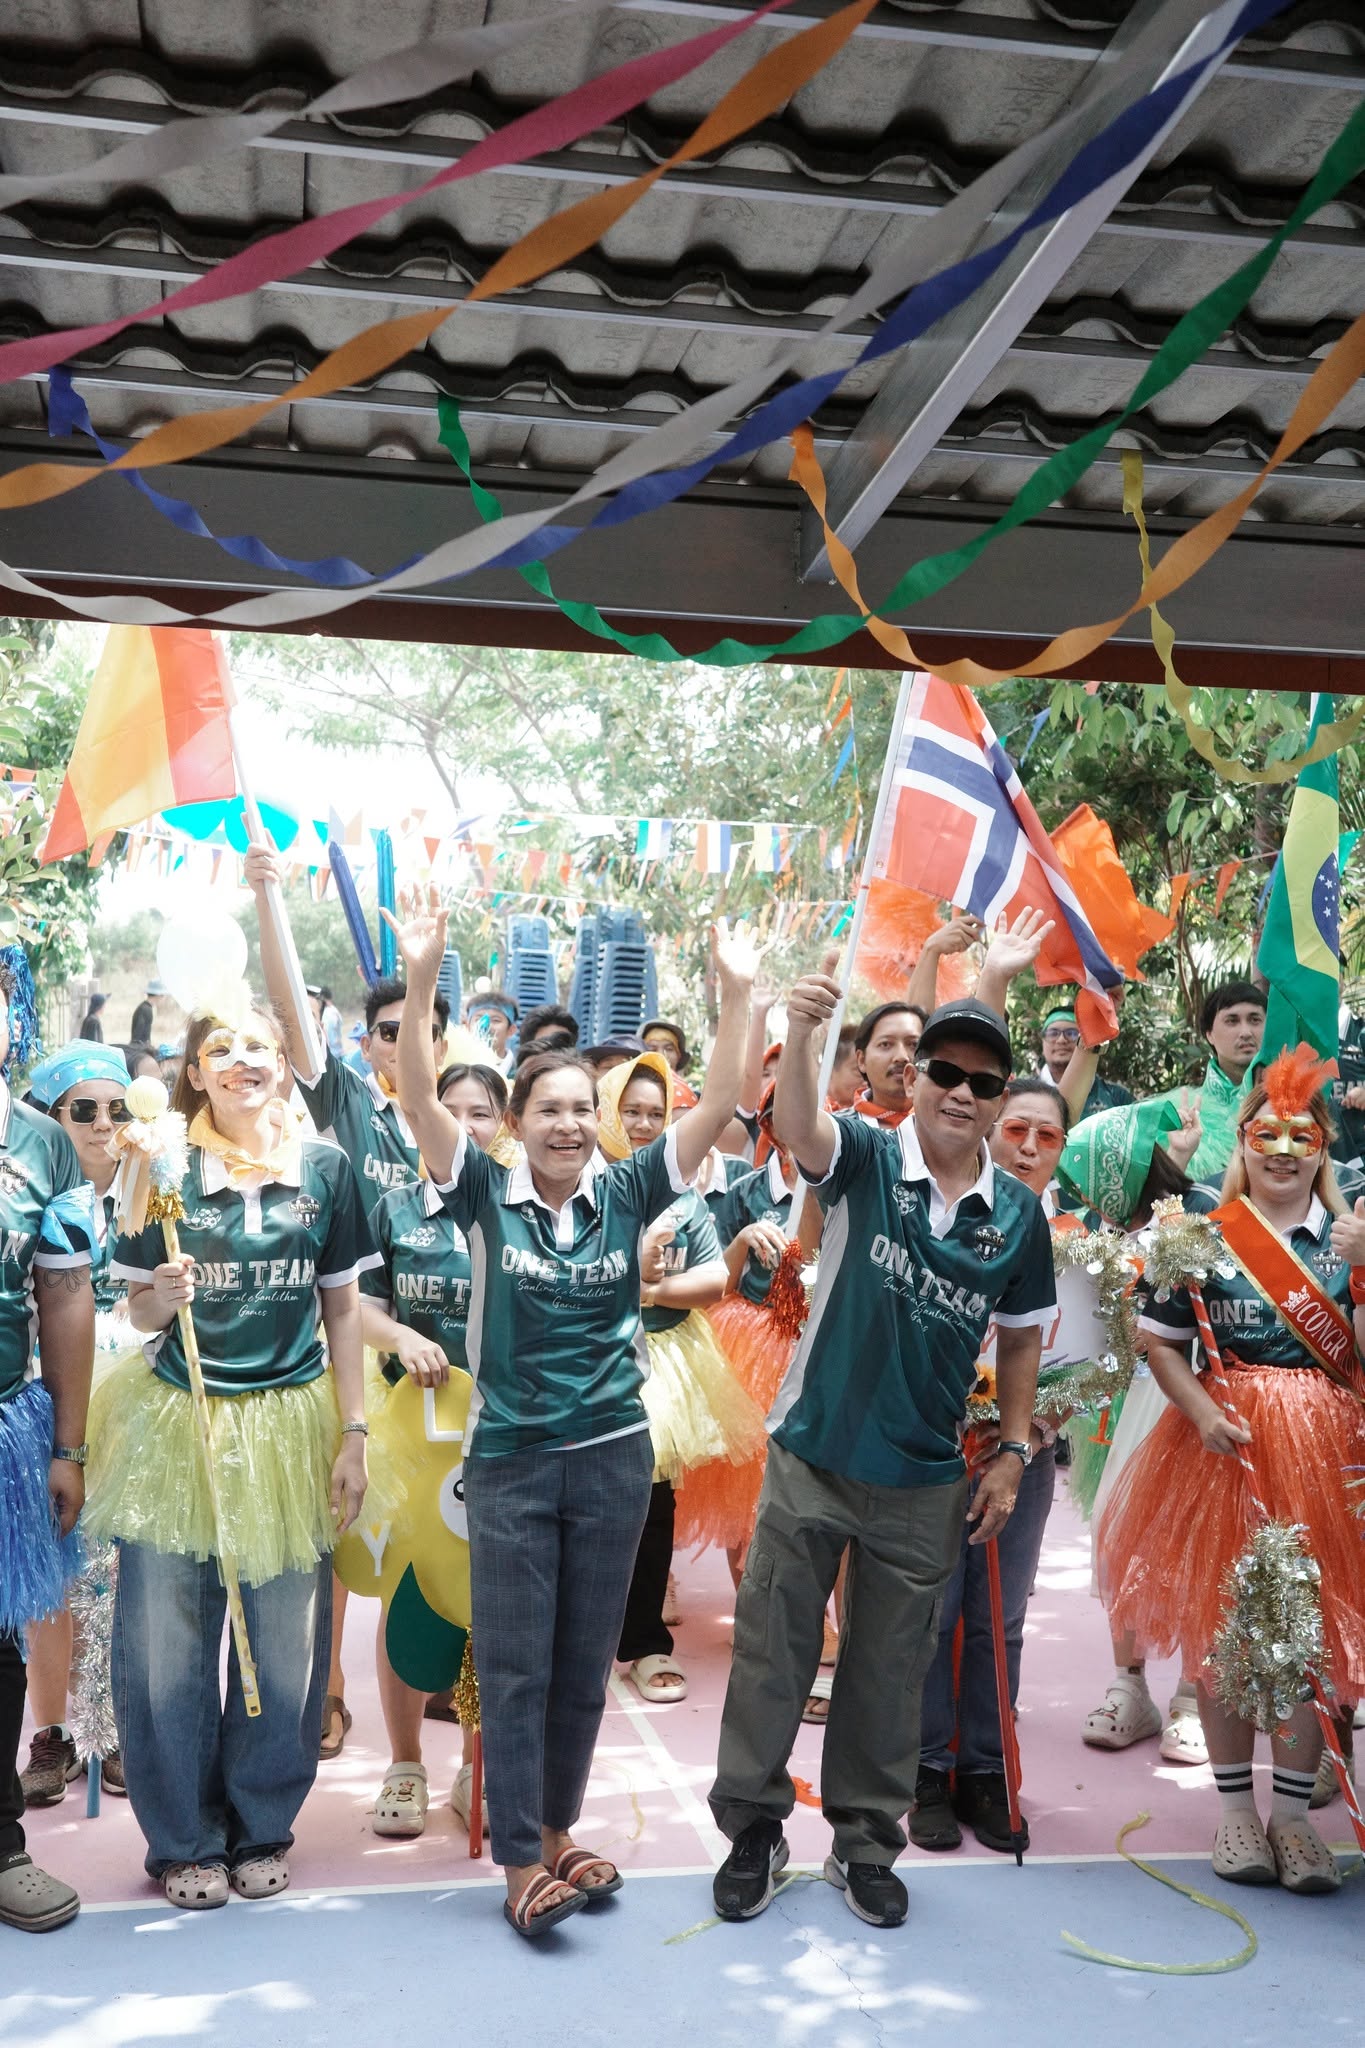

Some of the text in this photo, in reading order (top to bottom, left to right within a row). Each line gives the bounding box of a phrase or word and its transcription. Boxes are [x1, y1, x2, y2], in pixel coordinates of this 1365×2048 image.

[190, 1259, 316, 1290] ONE TEAM
[501, 1244, 629, 1286] ONE TEAM
[397, 1272, 446, 1303] ONE
[552, 1296, 581, 1310] Games
[917, 1268, 987, 1321] TEAM
[238, 1304, 267, 1317] Games
[1209, 1299, 1264, 1327] ONE
[1296, 1302, 1353, 1376] CONGR
